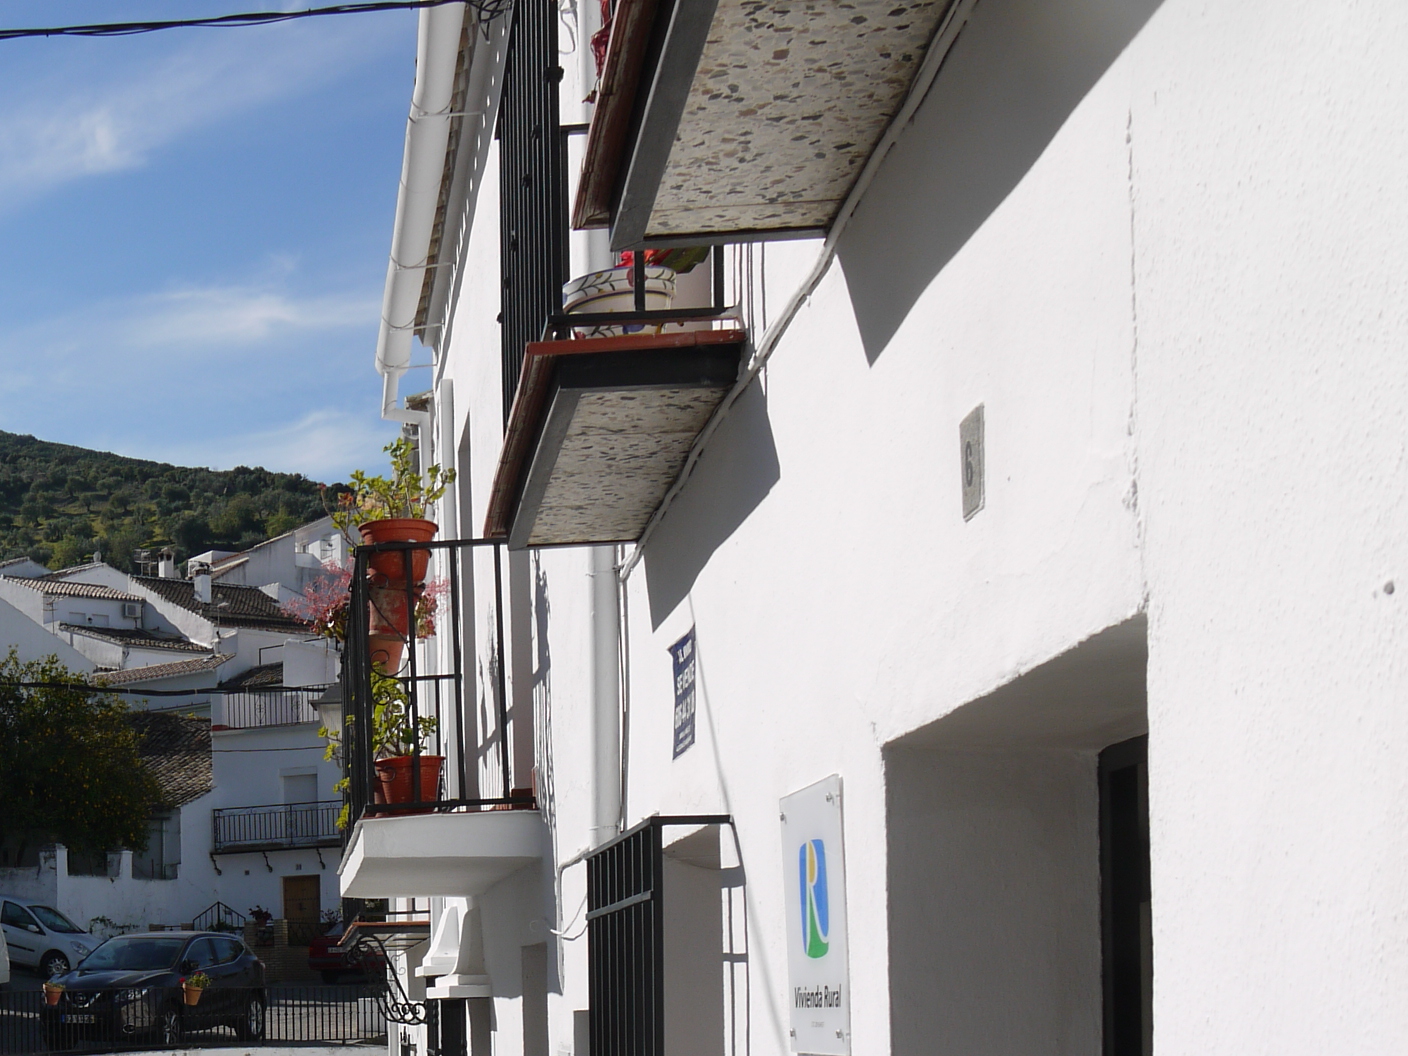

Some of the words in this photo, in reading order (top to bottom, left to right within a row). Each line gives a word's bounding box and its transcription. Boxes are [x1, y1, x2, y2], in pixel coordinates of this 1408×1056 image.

[965, 441, 974, 488] 6
[794, 985, 823, 1008] Vivienda
[824, 983, 842, 1008] Rural
